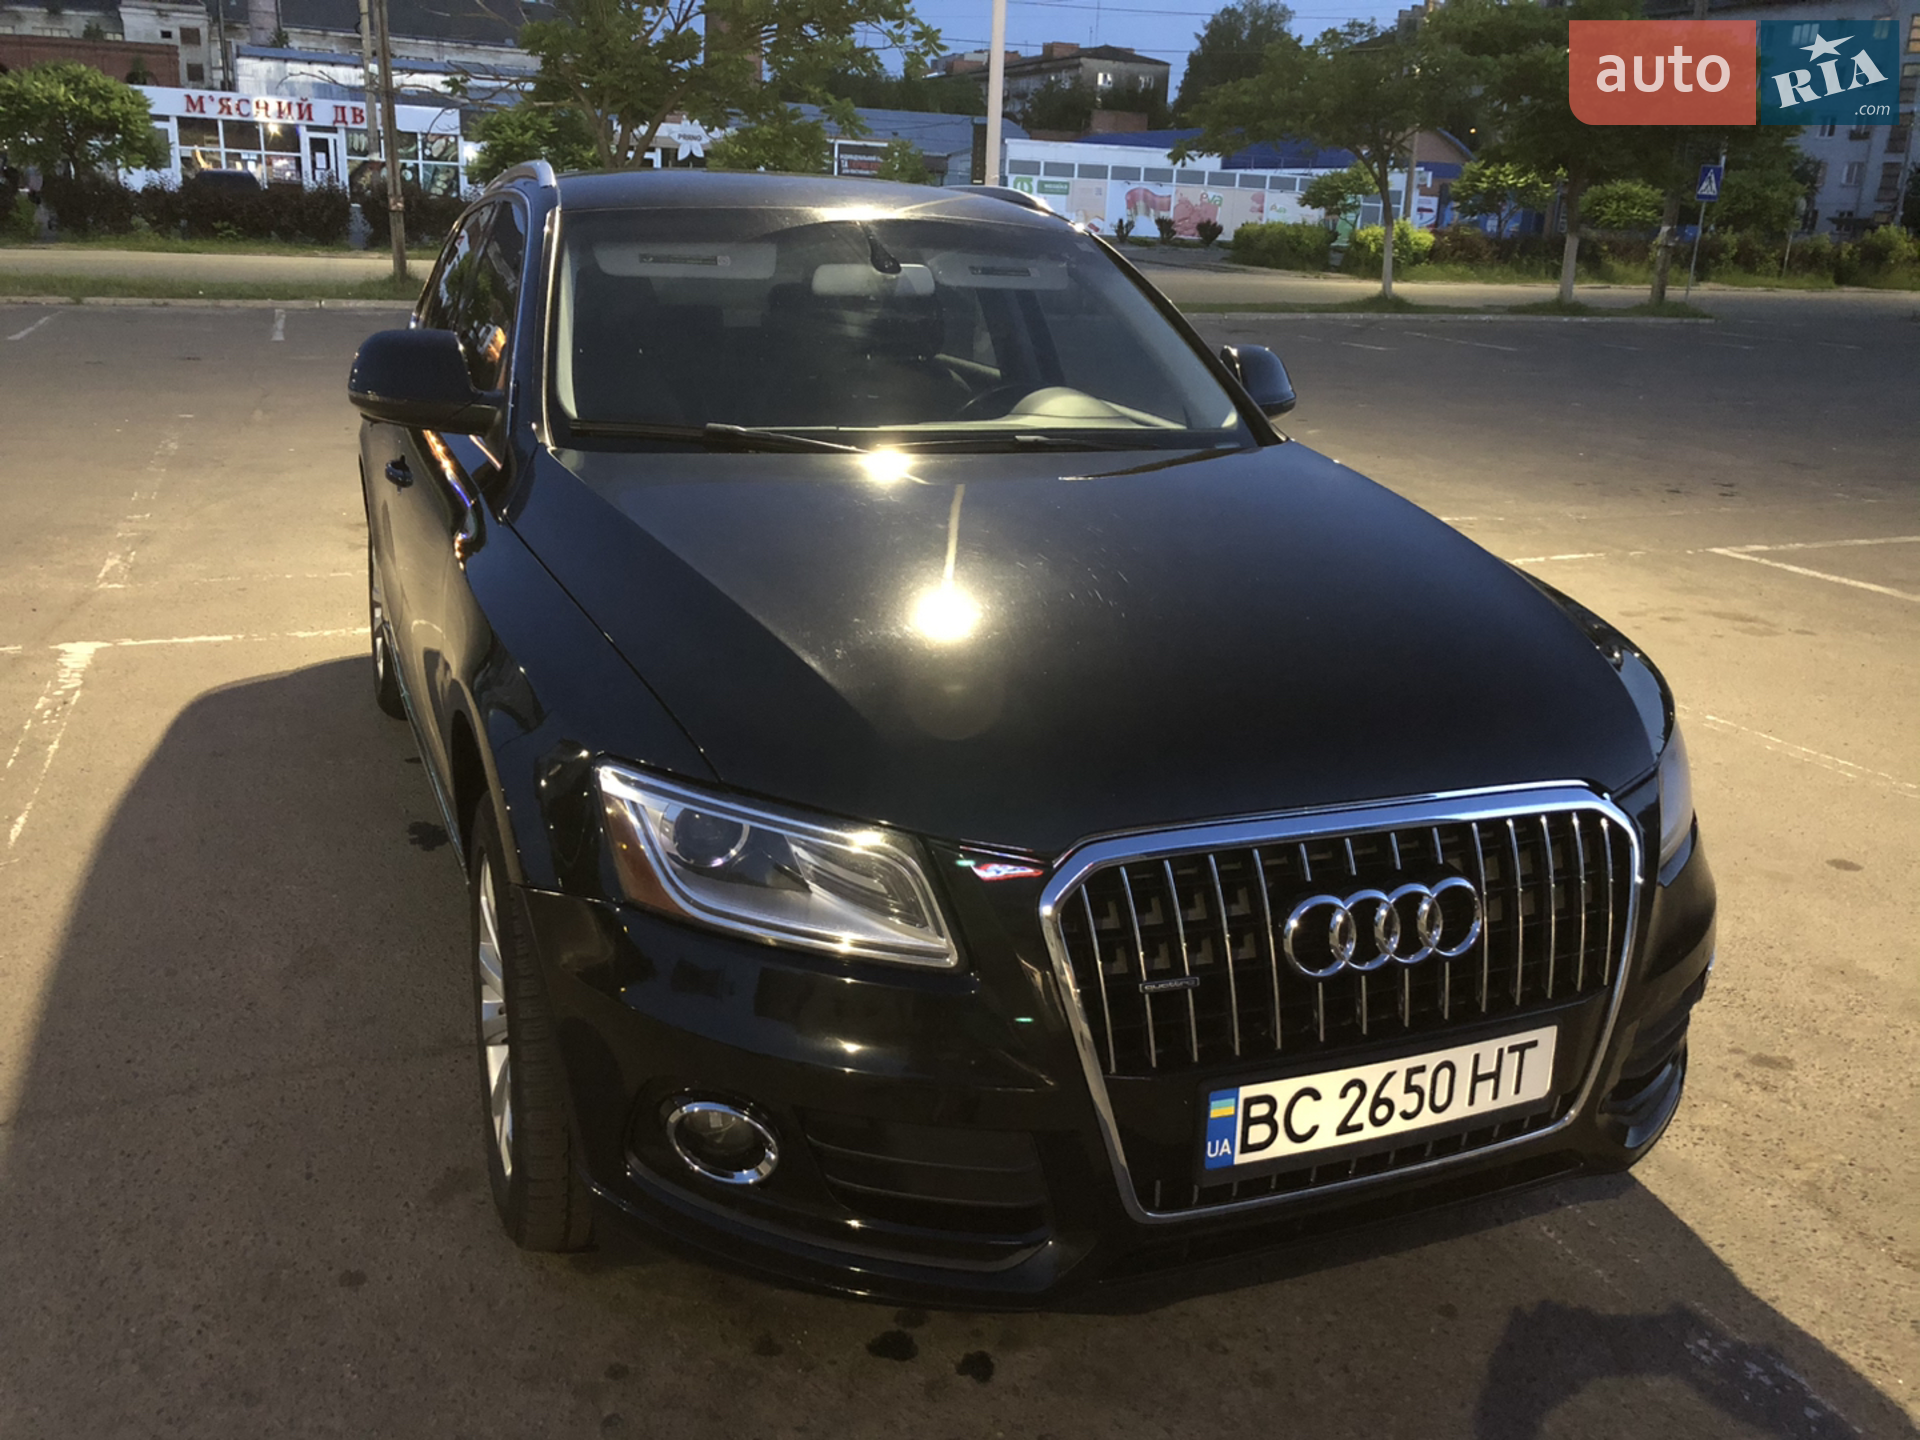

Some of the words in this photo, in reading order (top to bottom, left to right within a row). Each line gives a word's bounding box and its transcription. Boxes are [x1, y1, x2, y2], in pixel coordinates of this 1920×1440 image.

[1239, 1086, 1322, 1155] BC
[1335, 1060, 1457, 1136] 2650
[1467, 1039, 1539, 1107] HT
[1206, 1138, 1232, 1158] UA
